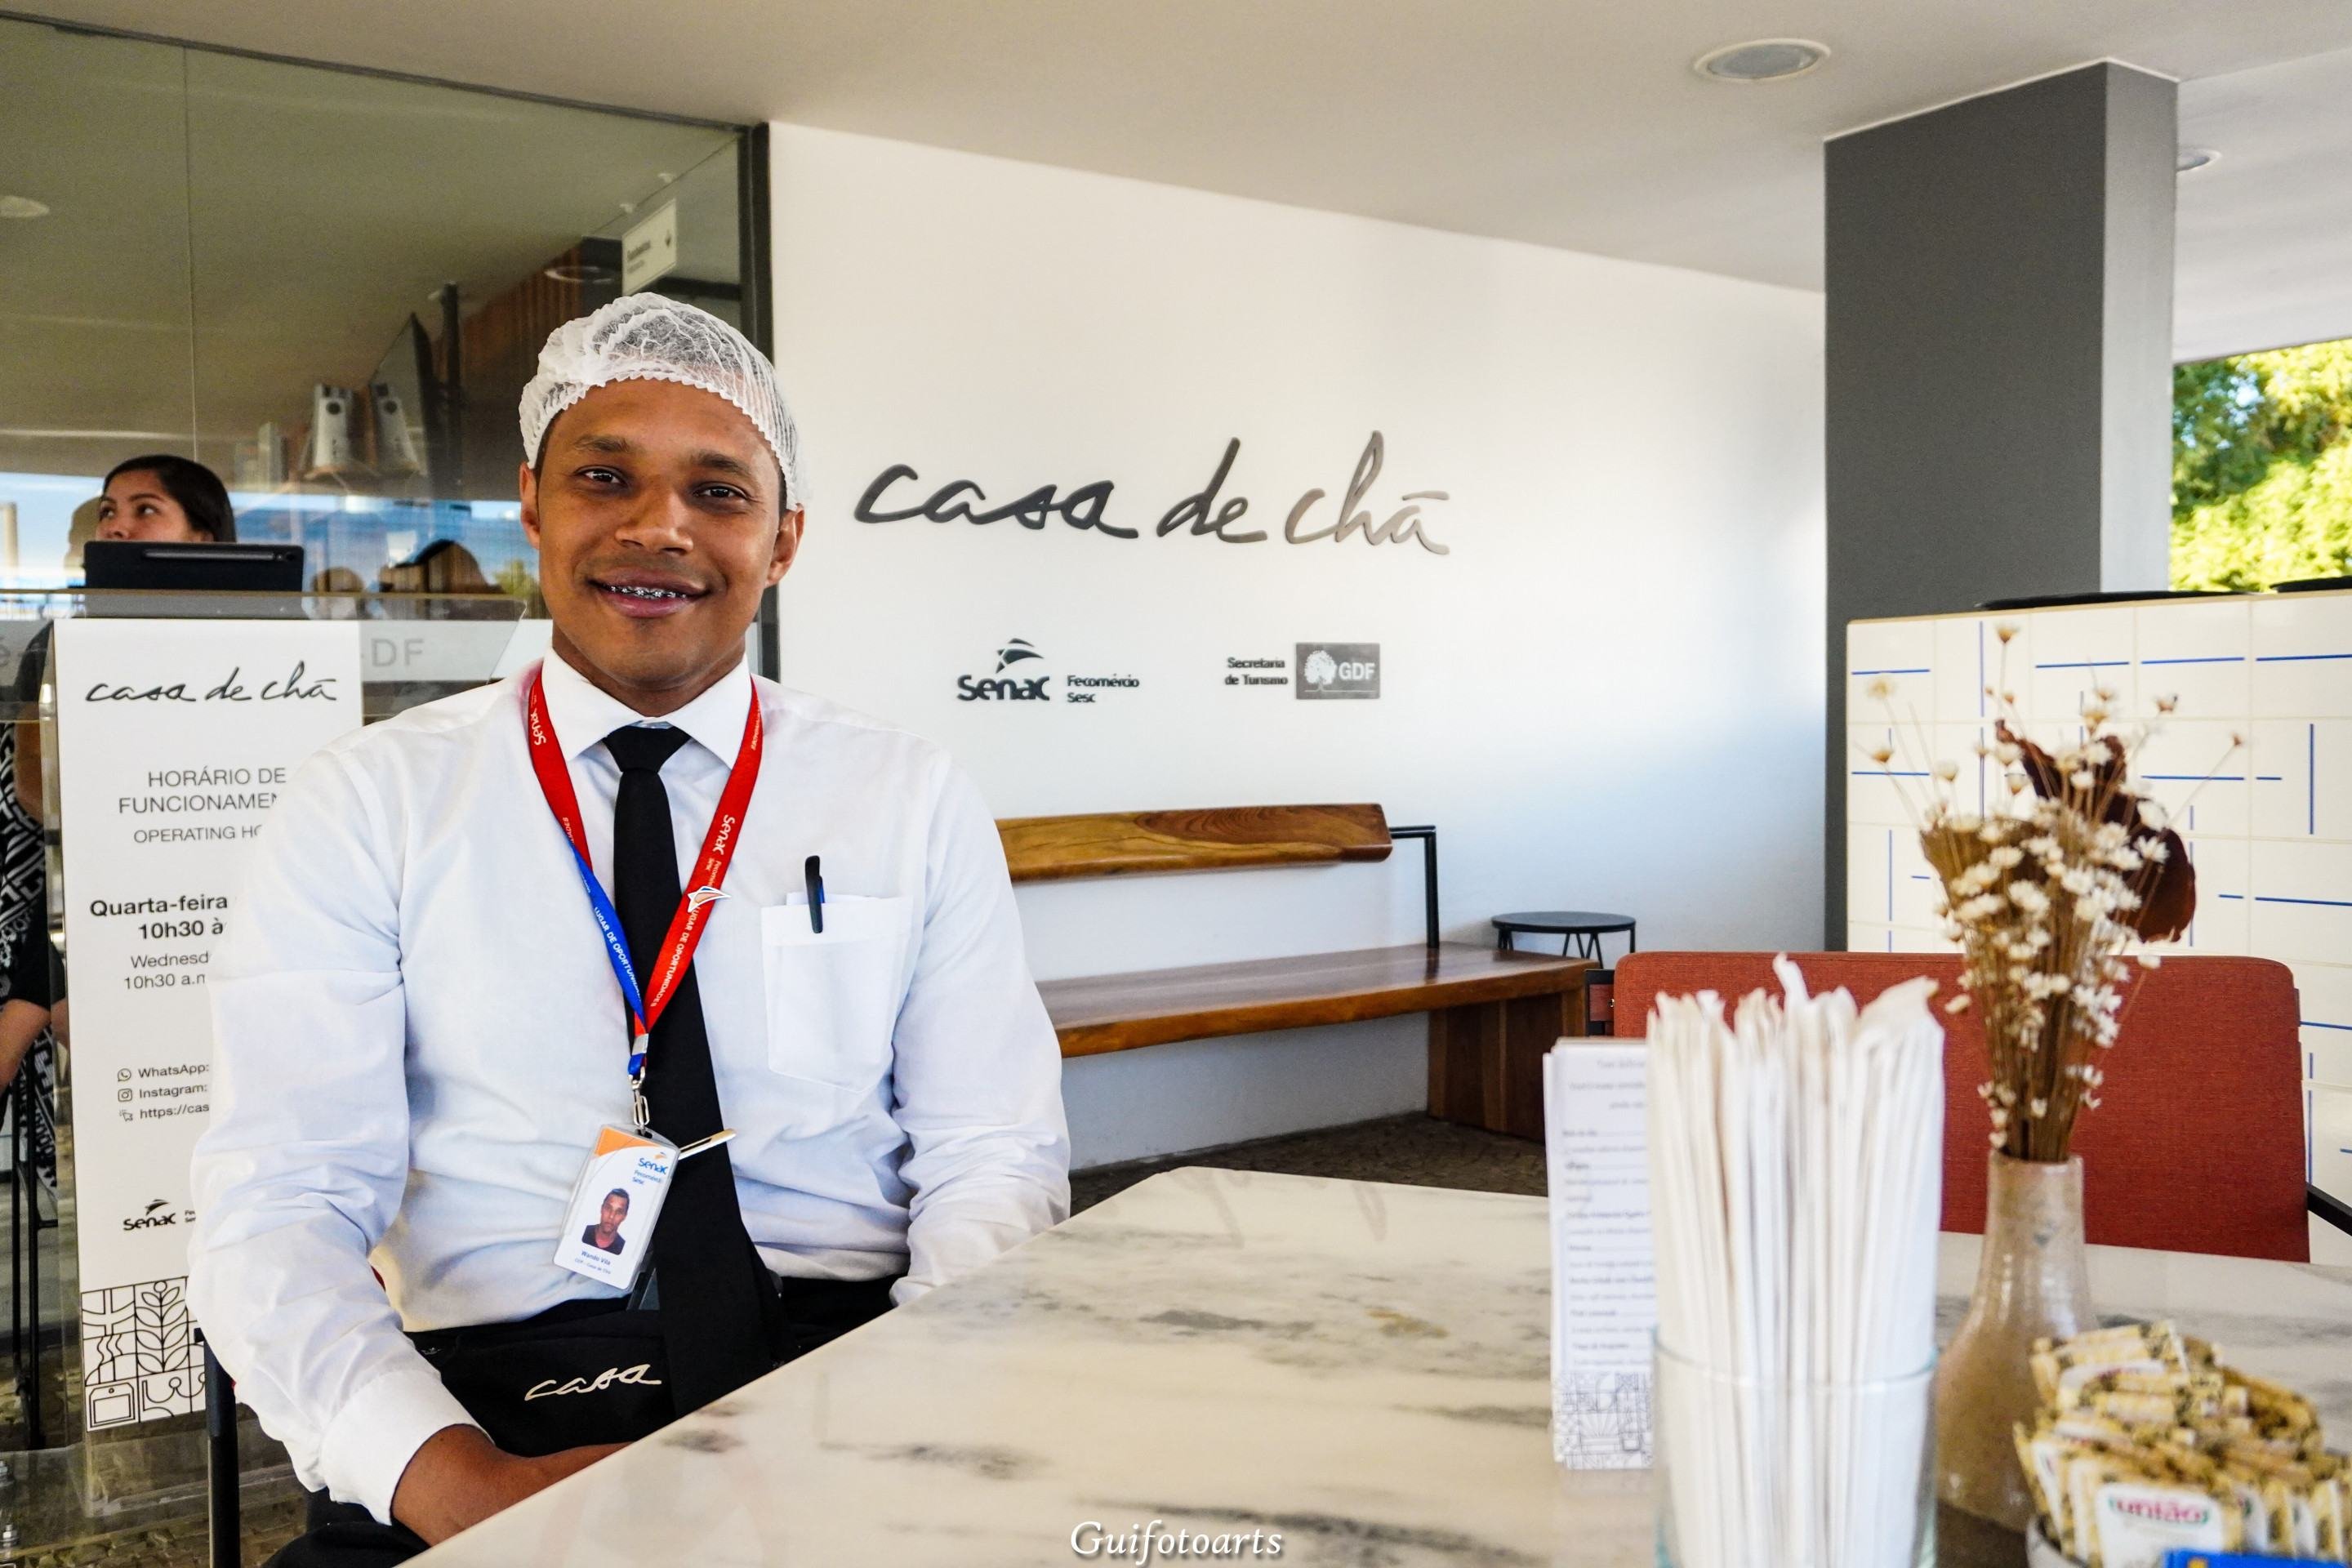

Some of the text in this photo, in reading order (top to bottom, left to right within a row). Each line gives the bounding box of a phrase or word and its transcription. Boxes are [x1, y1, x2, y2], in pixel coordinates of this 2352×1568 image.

[853, 463, 1139, 540] casa
[1156, 437, 1268, 545] de
[1227, 657, 1285, 669] Secretaria
[1338, 662, 1375, 681] GDF
[85, 683, 197, 702] casa
[204, 666, 252, 702] de
[1067, 673, 1140, 688] Fecomércio
[1224, 674, 1289, 685] de Turismo
[1067, 692, 1096, 703] Sesc
[147, 765, 287, 787] HORÁRIO DE
[133, 826, 236, 844] OPERATING
[89, 893, 229, 917] Quarta-feira
[138, 920, 204, 940] 10h30
[606, 931, 617, 944] DE
[679, 932, 690, 943] DE
[123, 973, 176, 990] 10h30
[138, 1063, 210, 1078] WhatsApp:
[139, 1084, 207, 1098] Instagram:
[524, 1364, 662, 1401] casa
